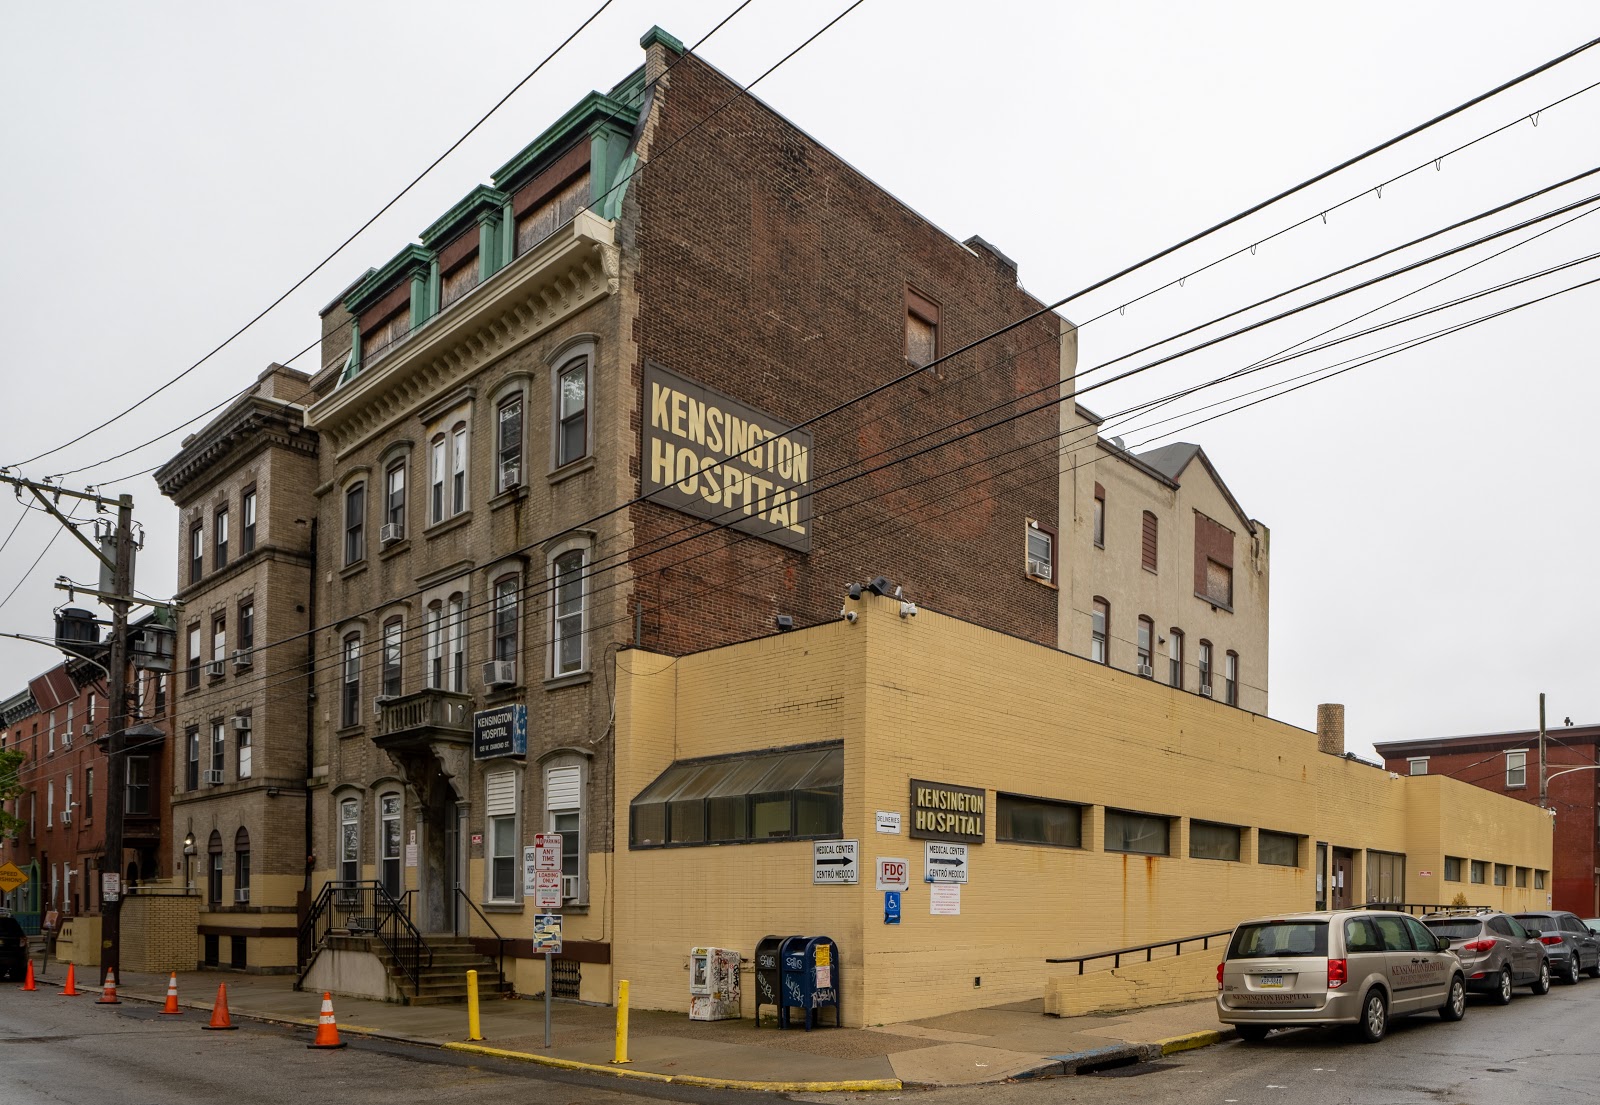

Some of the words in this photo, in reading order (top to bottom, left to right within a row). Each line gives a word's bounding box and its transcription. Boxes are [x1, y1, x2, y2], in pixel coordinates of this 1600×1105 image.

[651, 382, 808, 486] KENSINGTON
[651, 437, 806, 535] HOSPITAL
[477, 712, 512, 728] KENSINGTON
[481, 727, 507, 740] HOSPITAL
[917, 787, 984, 814] KENSINGTON
[877, 816, 900, 824] DELIVERIES
[916, 810, 984, 836] HOSPITAL
[536, 838, 544, 847] NO
[816, 845, 835, 854] MEDICAL
[836, 844, 854, 854] CENTER
[930, 846, 948, 854] MEDICAL
[949, 847, 966, 856] CENTER
[816, 868, 834, 879] CENTRÓ
[884, 864, 904, 876] FDC
[1392, 963, 1425, 976] KENSINGTON
[1425, 962, 1446, 972] HOSPITAL
